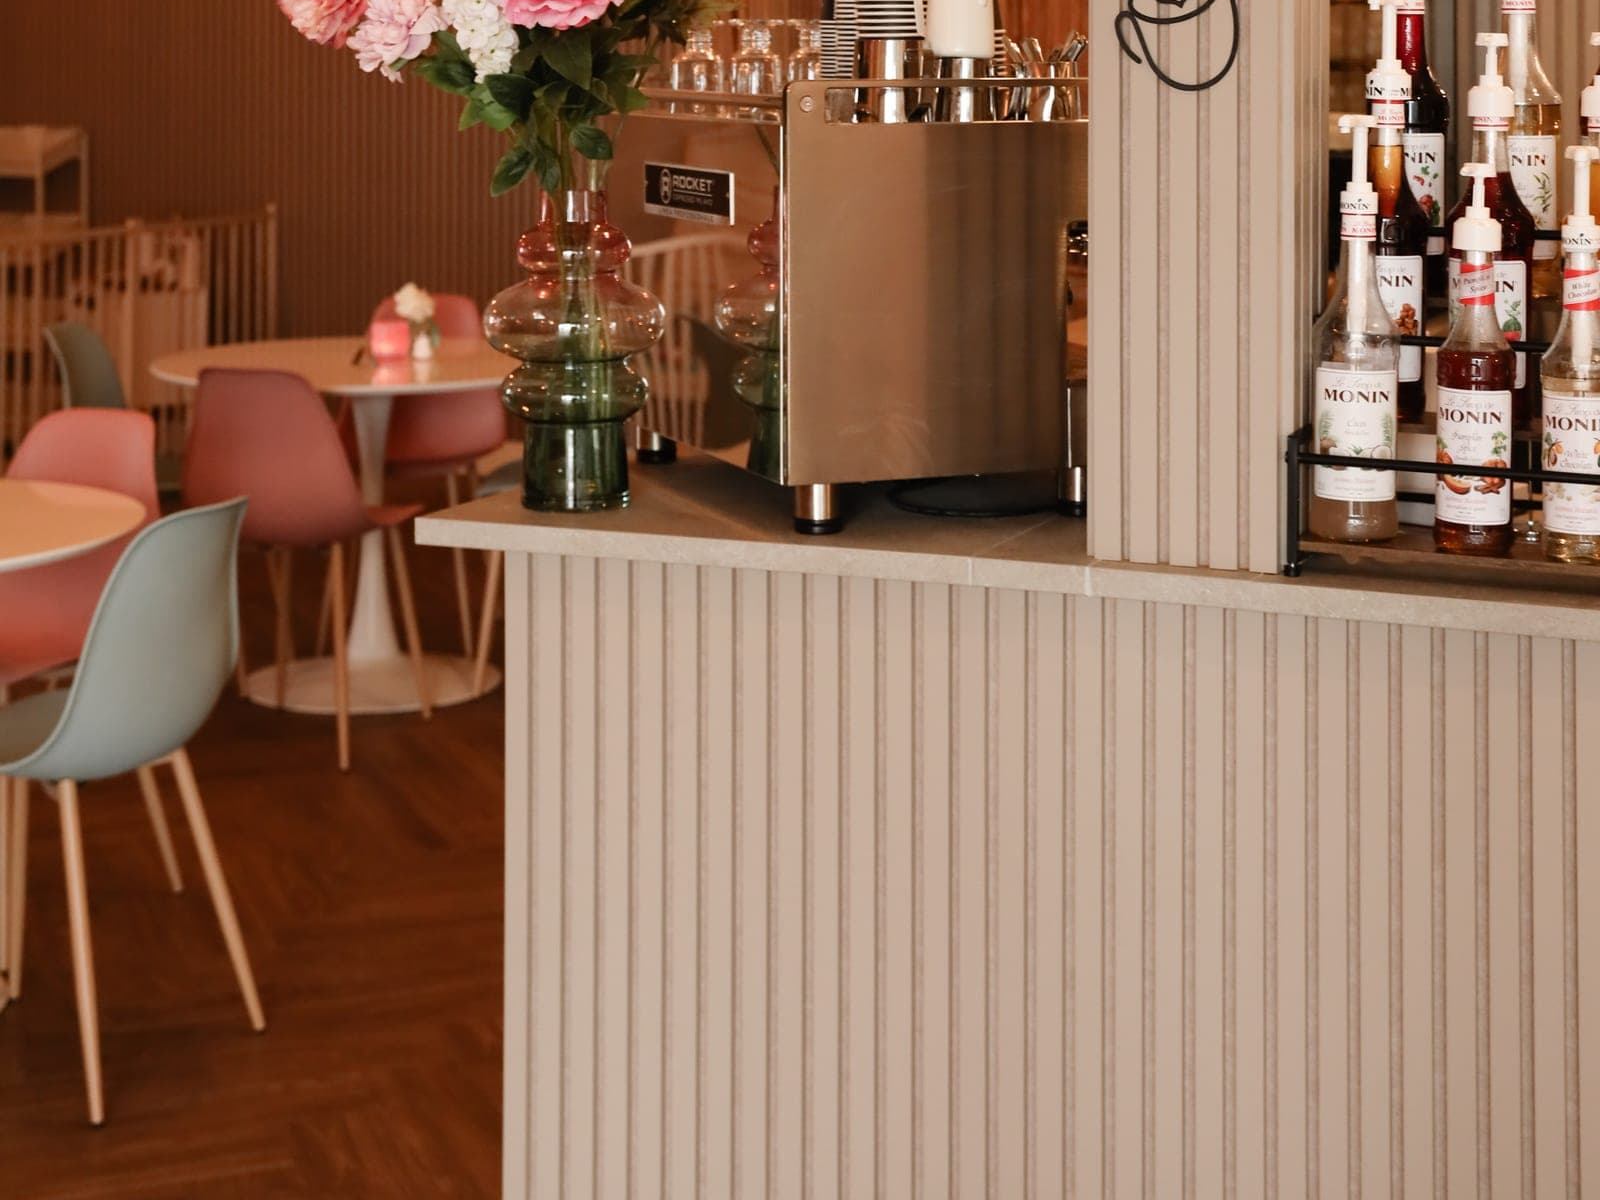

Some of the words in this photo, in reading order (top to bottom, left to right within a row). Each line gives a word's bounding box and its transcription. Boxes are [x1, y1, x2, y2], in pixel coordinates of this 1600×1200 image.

[672, 175, 713, 193] ROCKET
[1324, 388, 1390, 403] MONIN
[1440, 406, 1502, 424] MONIN
[1545, 414, 1600, 432] MONI
